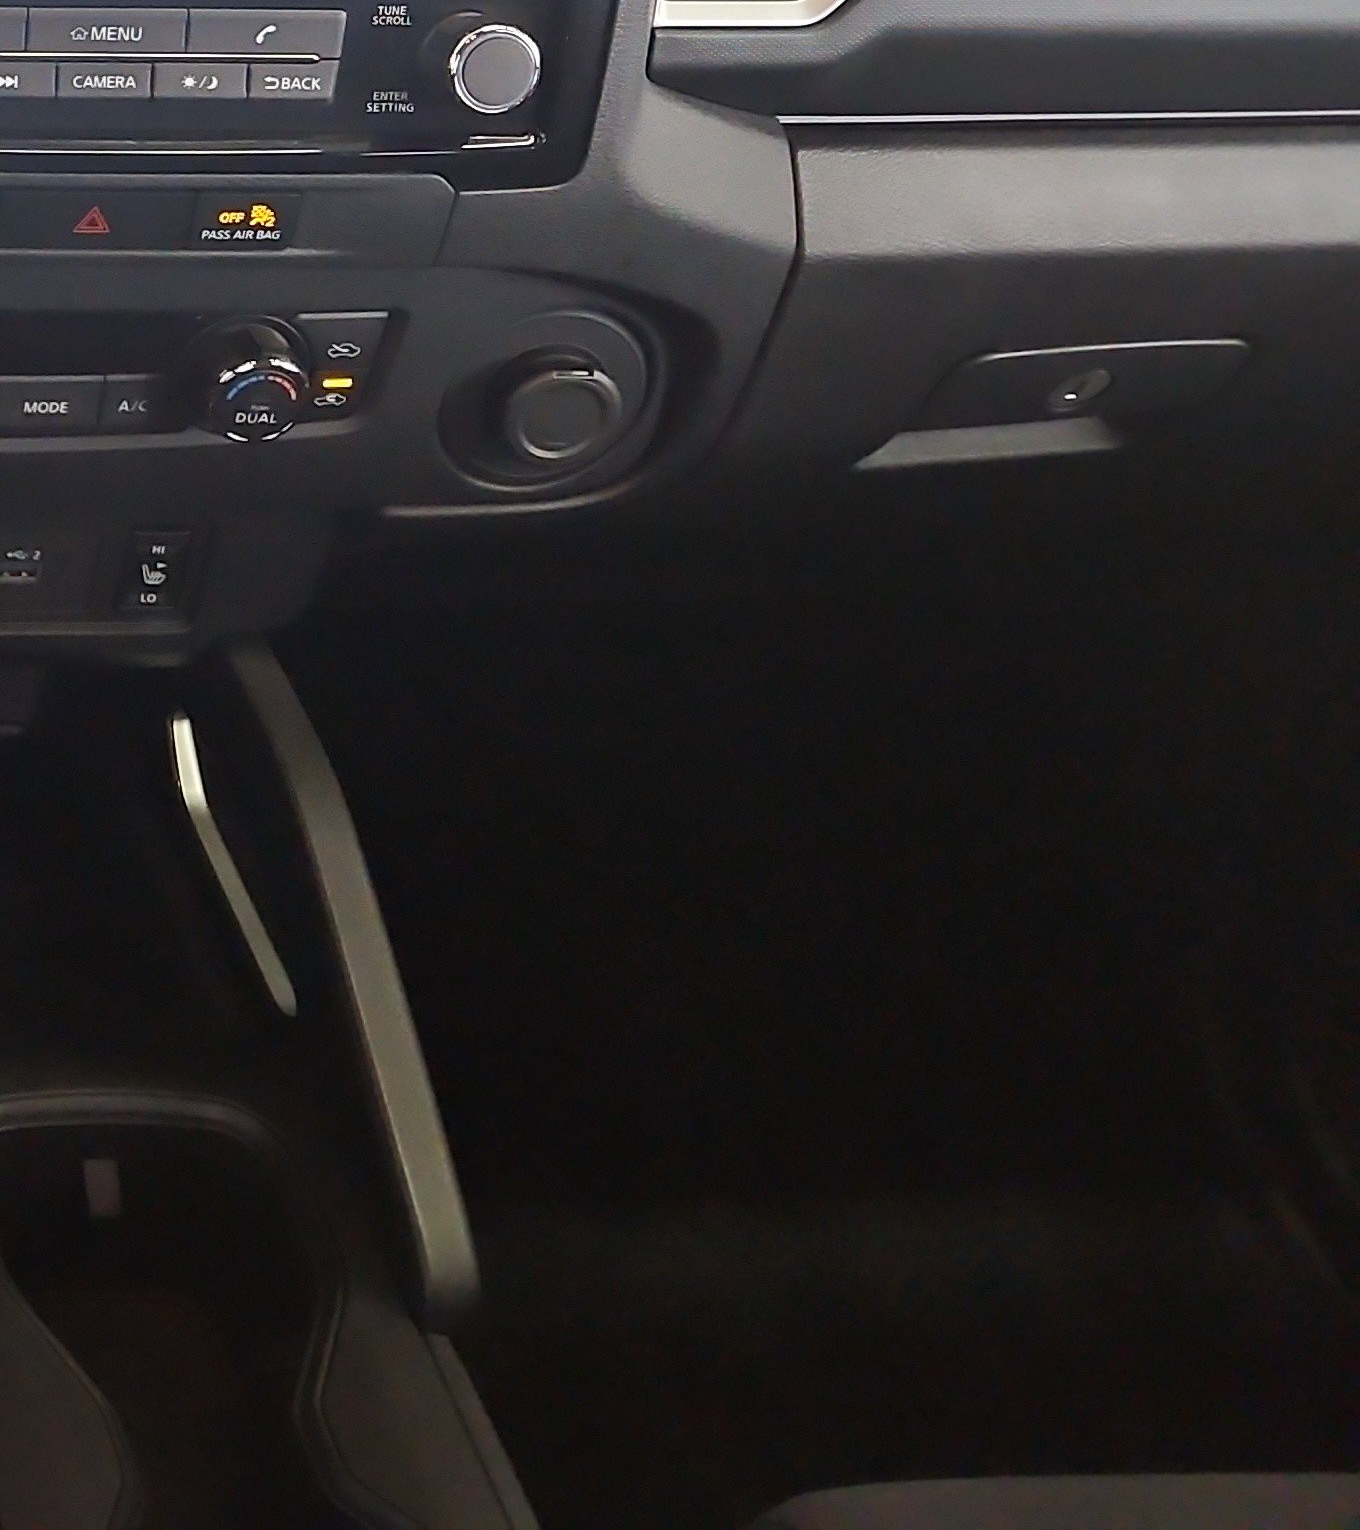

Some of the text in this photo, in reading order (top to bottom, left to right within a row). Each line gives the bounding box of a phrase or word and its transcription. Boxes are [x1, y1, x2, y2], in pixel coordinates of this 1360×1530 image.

[377, 5, 408, 16] TUNE
[371, 15, 412, 27] SCROLL
[90, 26, 144, 42] MENU
[72, 75, 137, 90] CAMERA
[281, 77, 322, 91] BACK
[372, 91, 409, 102] ENTER
[366, 102, 415, 114] SETTING
[218, 211, 245, 225] OFF
[201, 229, 281, 241] PASS AIR BAG
[23, 400, 70, 415] MODE
[117, 399, 149, 414] A/C
[235, 411, 278, 424] DUAL
[151, 544, 166, 555] HI
[139, 592, 157, 604] LO
